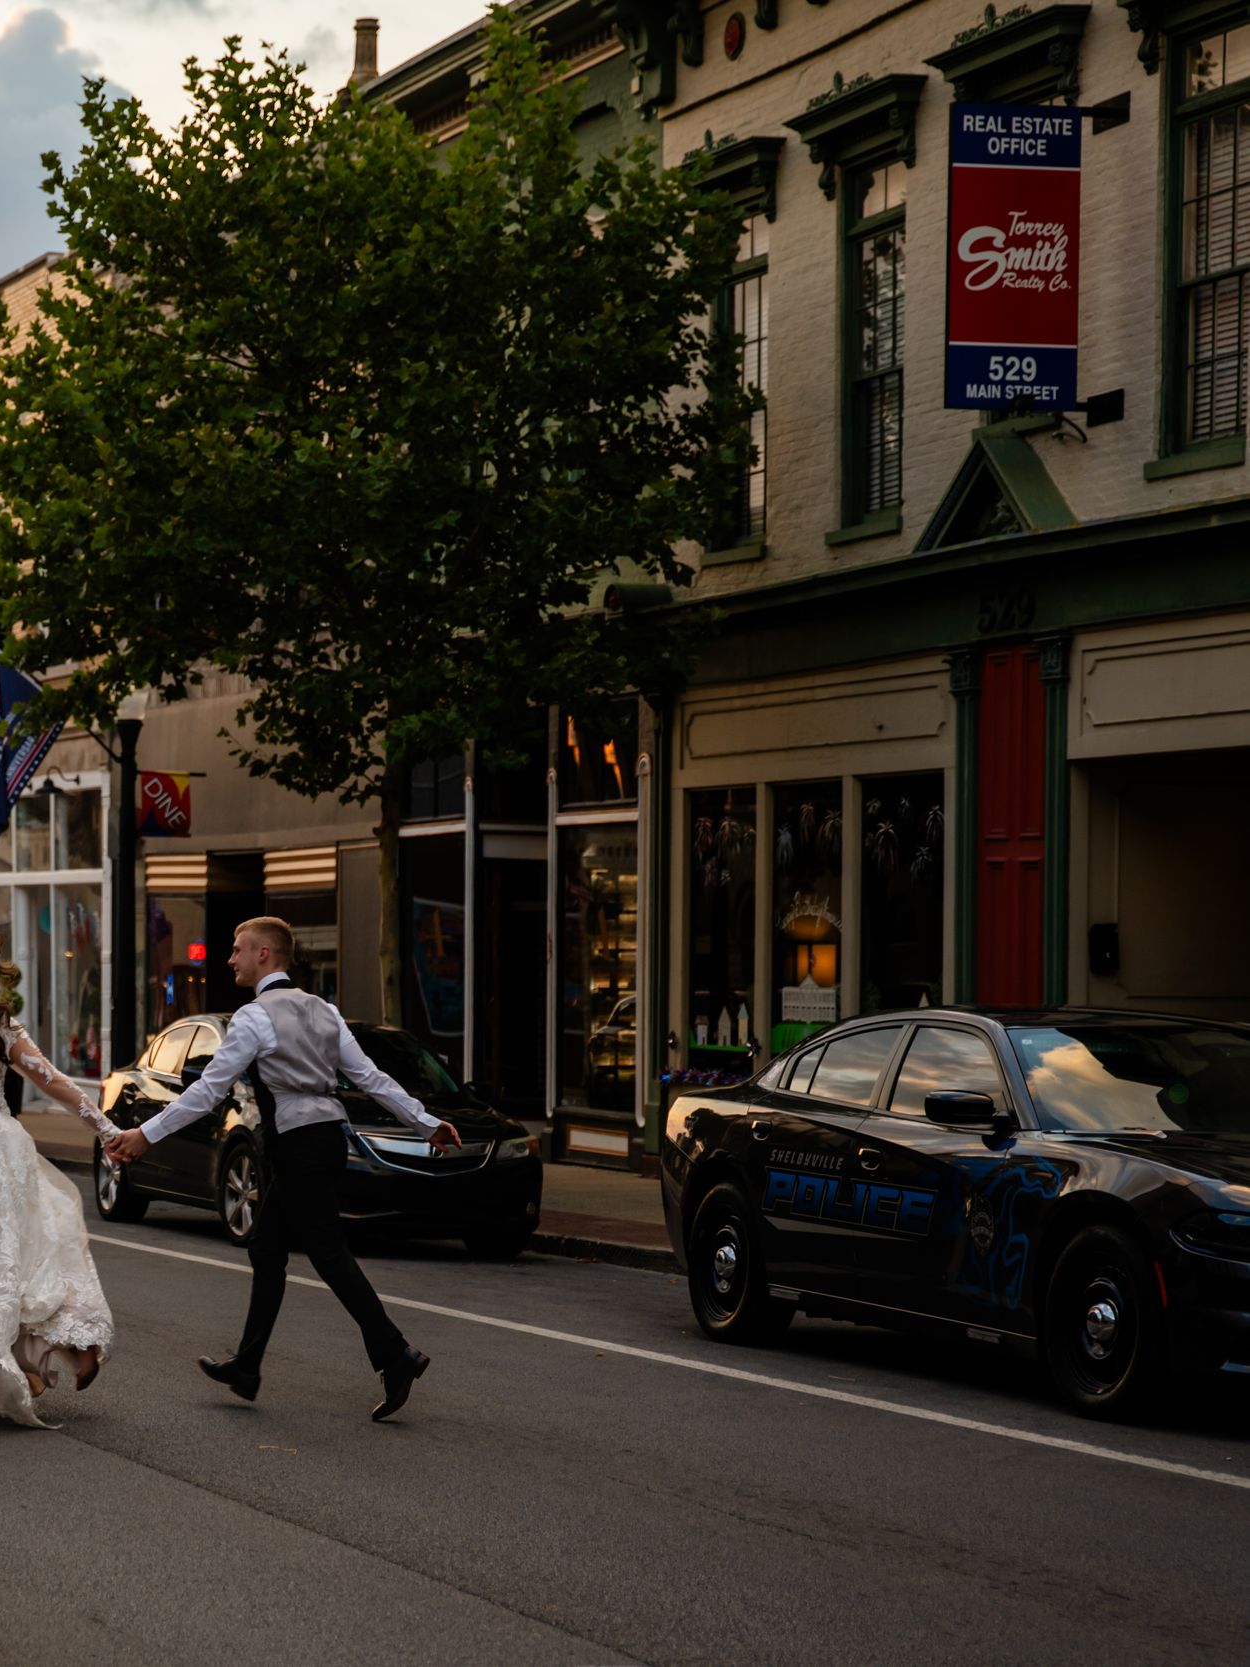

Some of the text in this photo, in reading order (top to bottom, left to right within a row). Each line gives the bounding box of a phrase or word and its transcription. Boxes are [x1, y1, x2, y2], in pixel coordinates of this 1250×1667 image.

[962, 114, 1073, 136] REAL ESTATE
[987, 136, 1047, 156] OFFICE
[1007, 210, 1065, 243] Torrey
[957, 225, 1069, 292] Smith
[1001, 271, 1072, 293] Realty Co.
[988, 355, 1038, 382] 529
[965, 383, 1060, 400] MAIN STREET
[143, 777, 187, 829] DINE
[769, 1148, 845, 1171] SHELBYVILLE
[763, 1168, 937, 1235] POLICE
